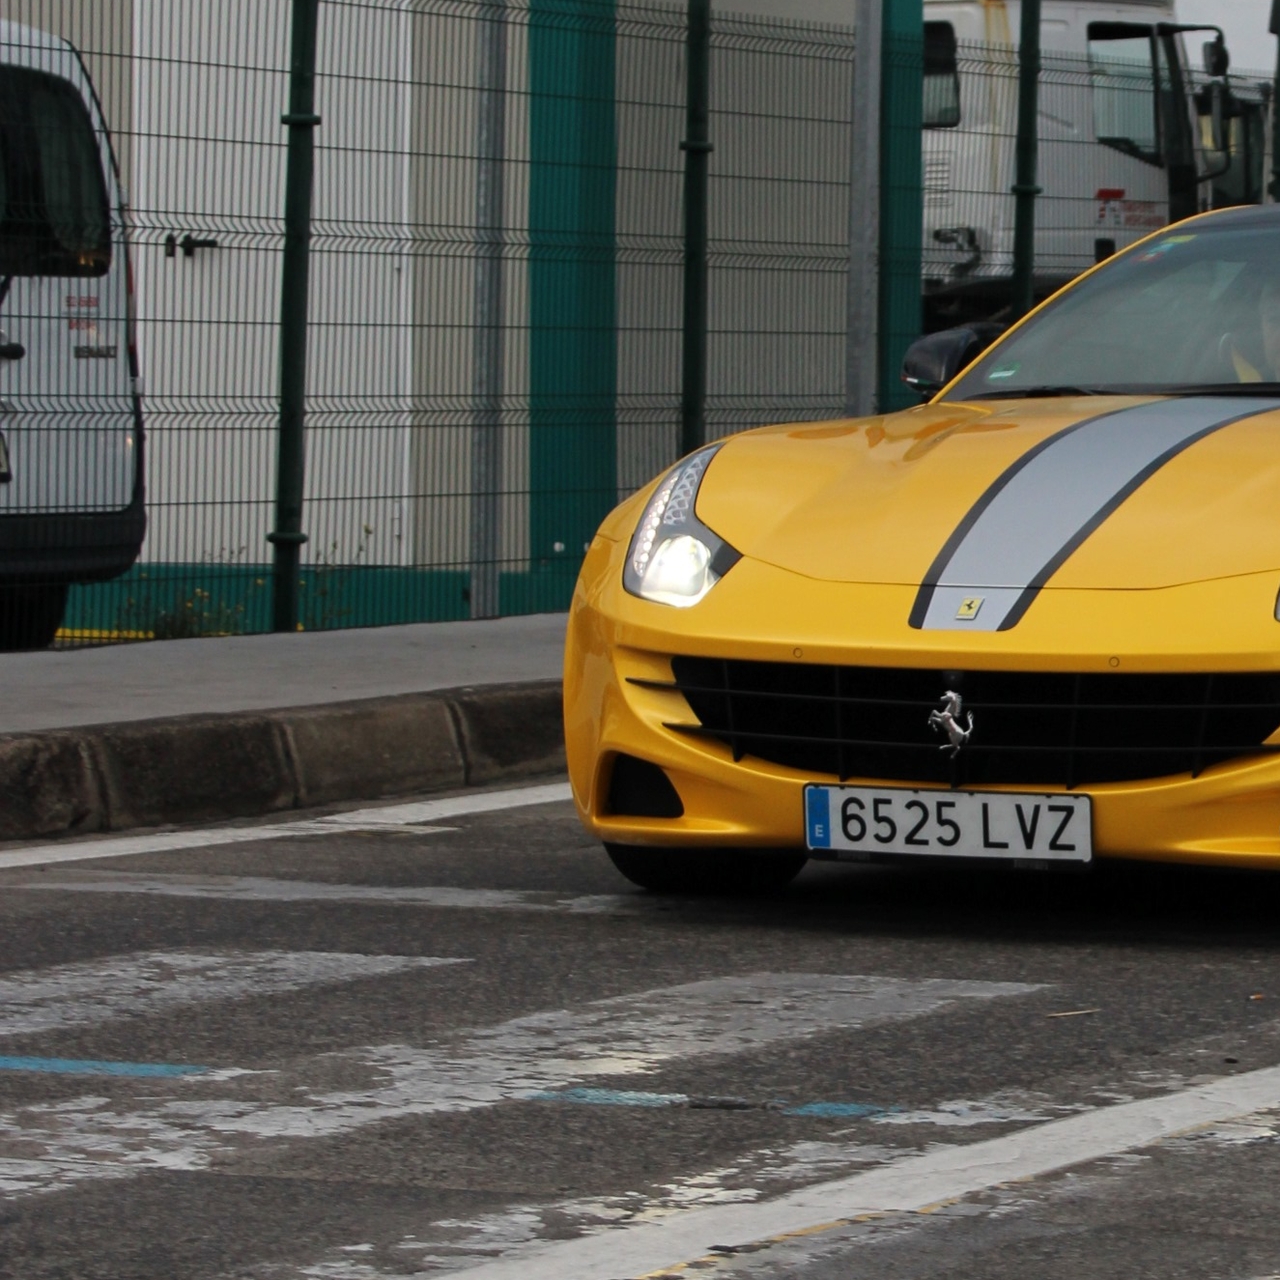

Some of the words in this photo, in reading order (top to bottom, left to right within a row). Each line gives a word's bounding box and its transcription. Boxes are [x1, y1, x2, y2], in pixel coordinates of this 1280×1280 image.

[815, 824, 824, 837] E
[841, 796, 961, 847] 6525
[981, 802, 1076, 851] LVZ
